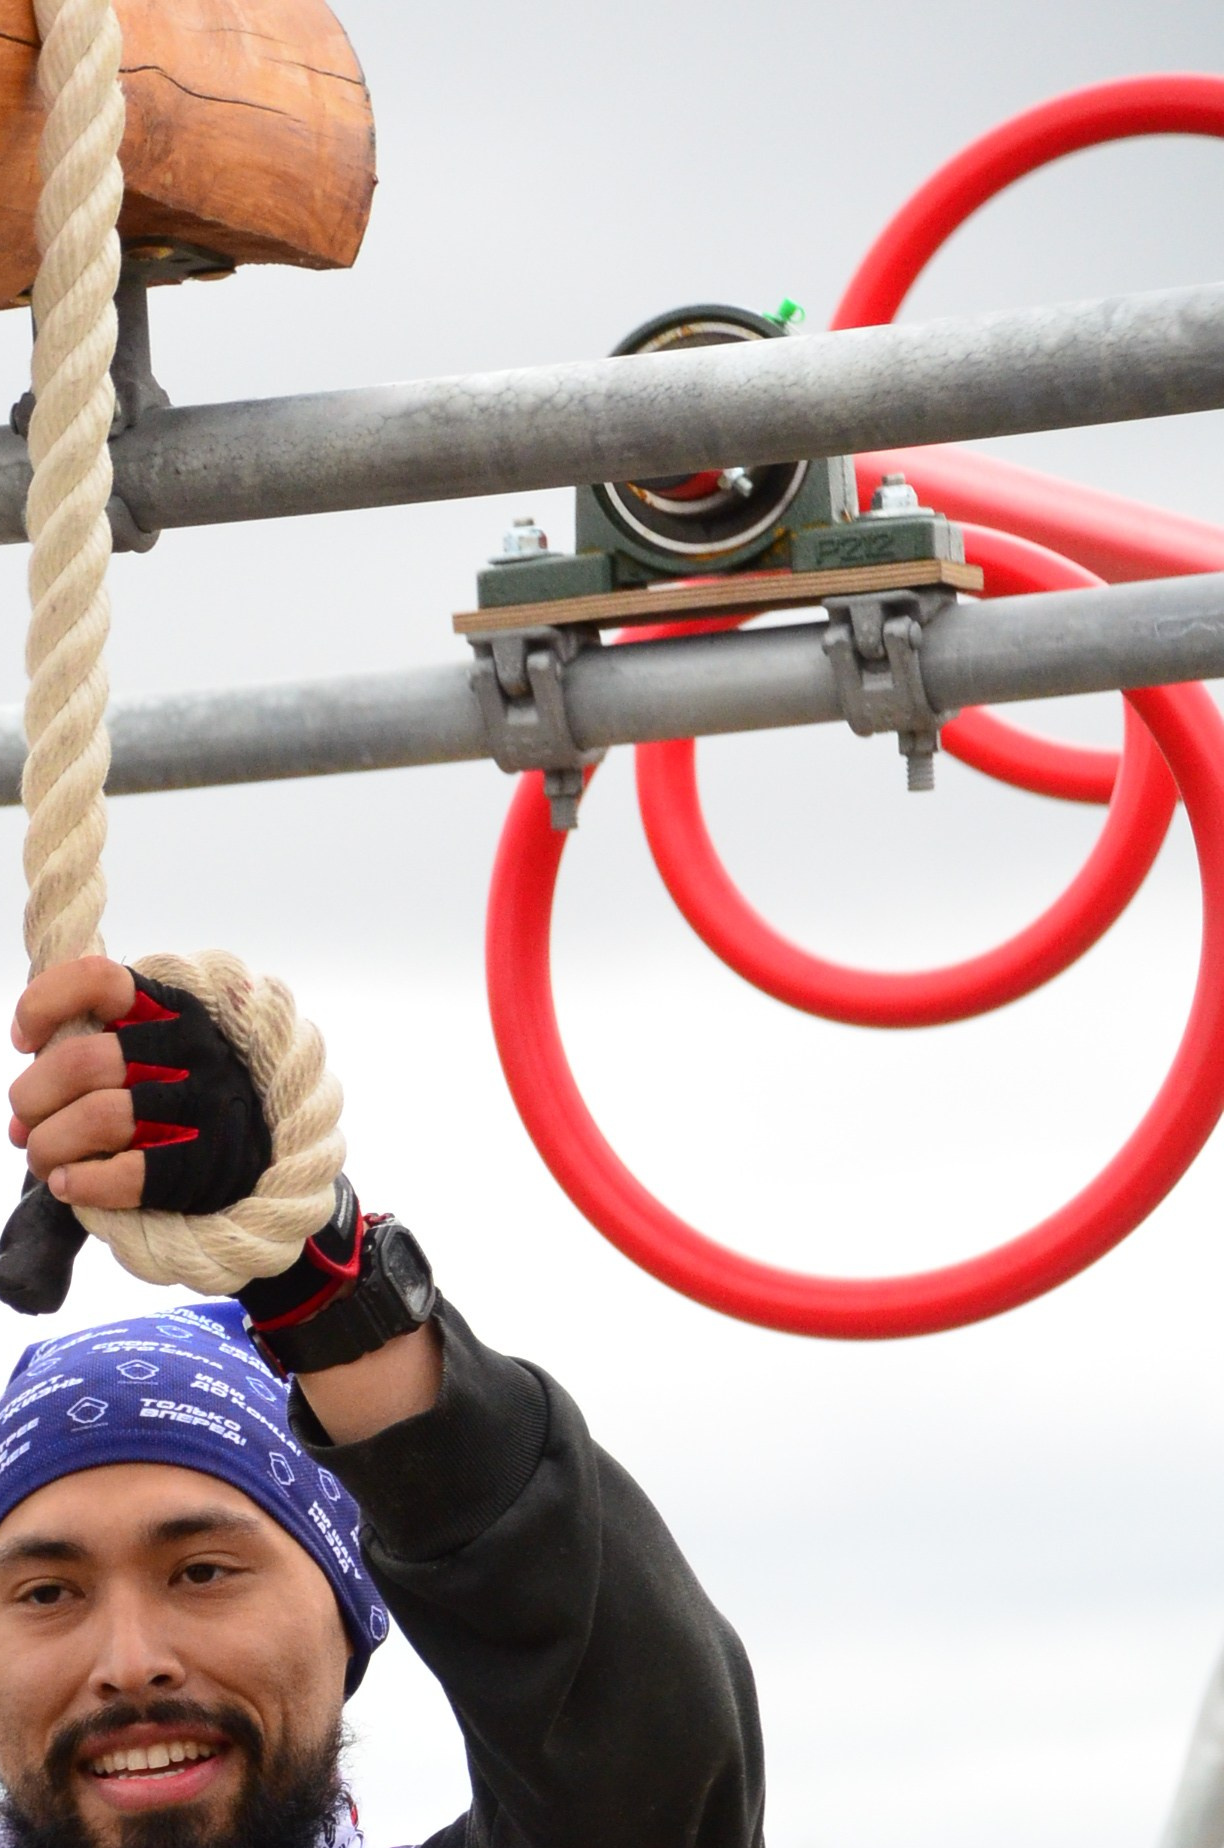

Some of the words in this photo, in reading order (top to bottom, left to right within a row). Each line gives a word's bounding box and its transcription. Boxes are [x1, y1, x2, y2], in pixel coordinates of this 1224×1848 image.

[190, 1380, 229, 1398] ДО
[194, 1373, 246, 1401] ИДИ
[140, 1398, 242, 1432] ТОЛЬКО
